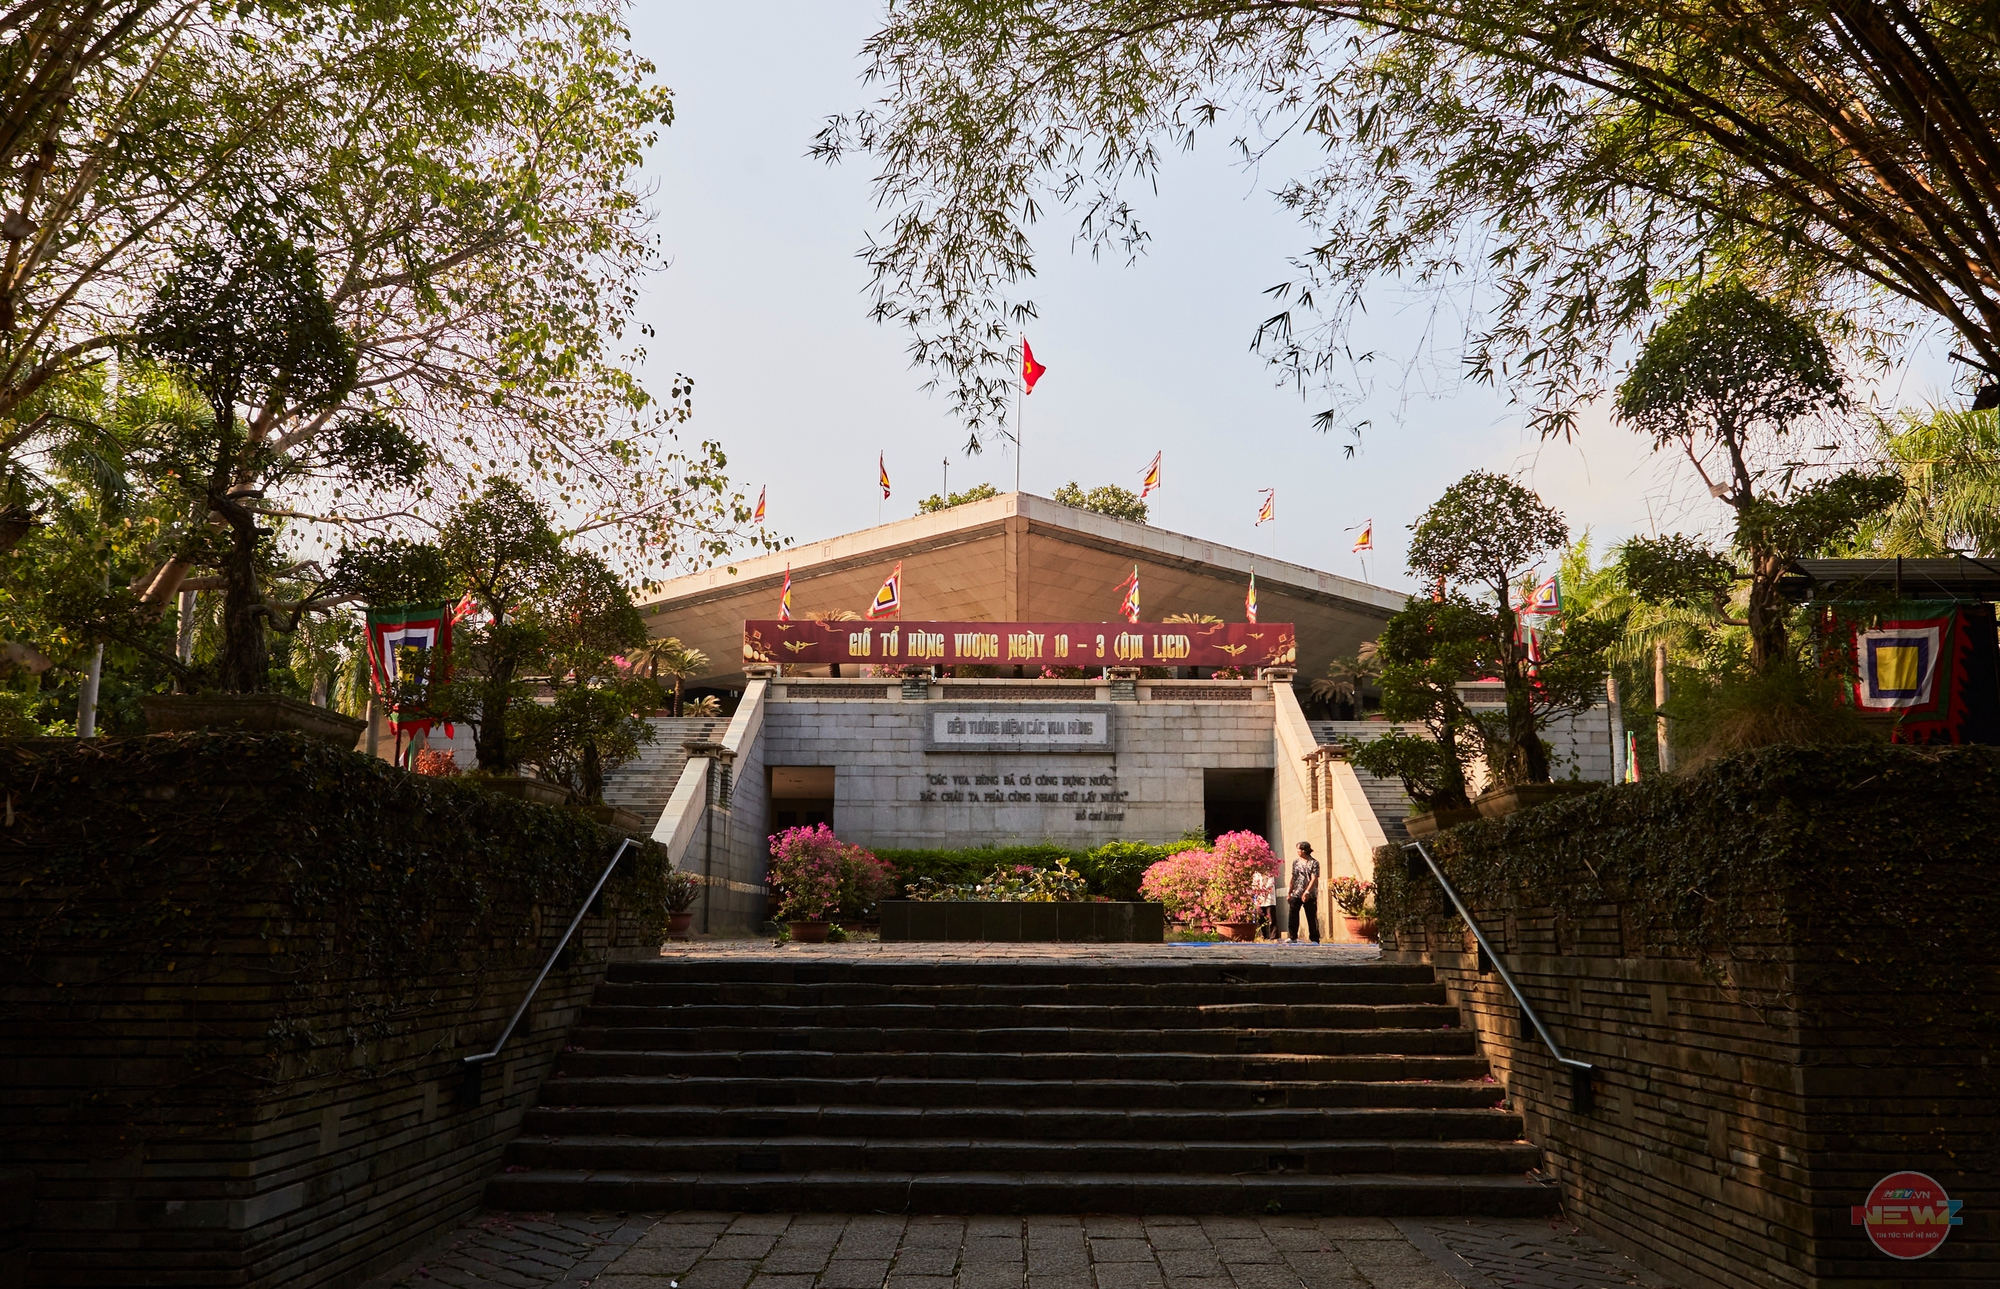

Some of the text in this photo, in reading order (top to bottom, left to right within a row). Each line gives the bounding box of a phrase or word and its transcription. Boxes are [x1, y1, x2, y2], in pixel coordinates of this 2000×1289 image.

[849, 627, 873, 656] GIỖ
[880, 625, 900, 657] TỔ
[907, 628, 945, 660] HÙNG
[953, 631, 999, 660] VƯƠNG
[1007, 630, 1045, 660] NGÀY
[1054, 633, 1069, 658] 10
[1096, 634, 1105, 658] 3
[1113, 631, 1144, 661] (ÂM
[1152, 634, 1191, 662] LỊCH)
[1026, 718, 1045, 735] CÁC
[1047, 721, 1066, 735] VUA
[1067, 718, 1093, 735] HÙNG
[953, 775, 970, 786] VUA
[975, 773, 999, 786] HÙNG
[1020, 773, 1031, 786] CÓ
[941, 789, 964, 802] CHÁU
[968, 793, 980, 802] TA
[1007, 790, 1031, 802] CÙNG
[1035, 793, 1059, 802] NHAU
